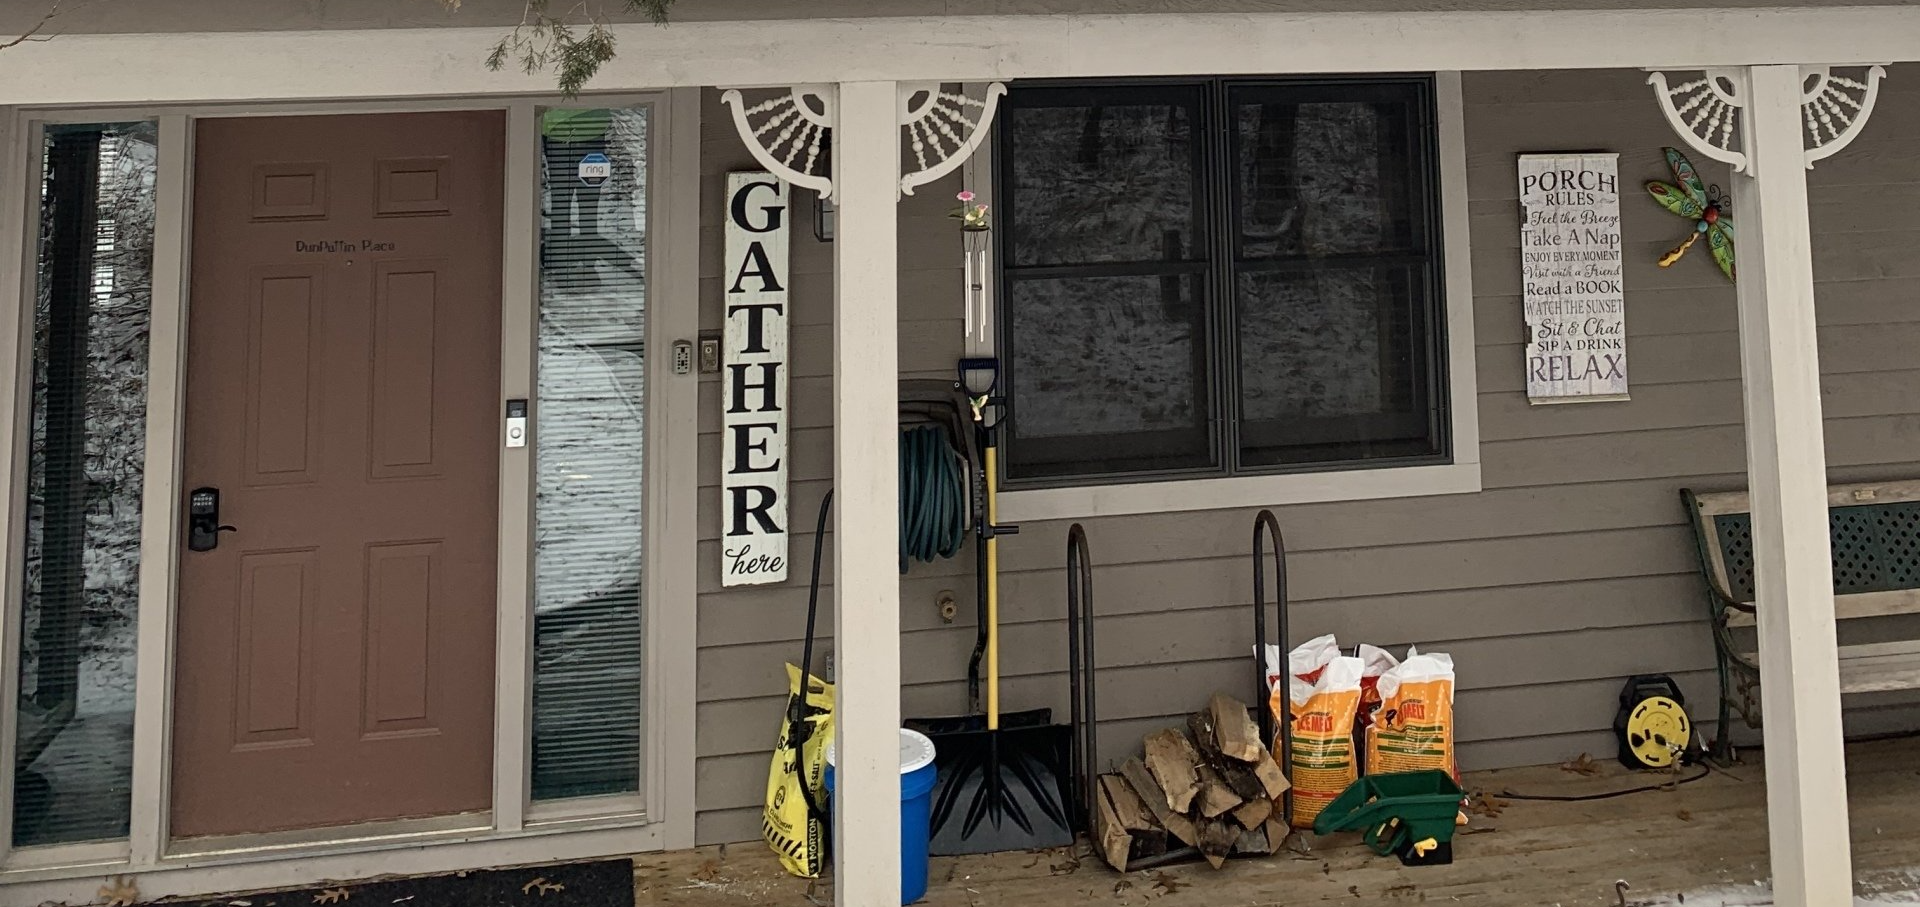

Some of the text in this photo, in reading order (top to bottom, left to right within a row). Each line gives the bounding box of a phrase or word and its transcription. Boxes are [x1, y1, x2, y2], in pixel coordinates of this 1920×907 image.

[586, 165, 604, 175] ring
[1522, 170, 1616, 196] PORCH
[1545, 192, 1595, 206] RULES
[1531, 210, 1619, 227] Feel the Breeze
[1521, 228, 1620, 249] Take A Nap
[1525, 250, 1620, 262] ENJOY EVERY MOMENT
[1523, 264, 1549, 278] Visit
[1551, 266, 1573, 277] with
[1584, 264, 1621, 278] Friend
[1527, 280, 1621, 296] Read a BOOK
[1526, 299, 1623, 316] WATCH THE SUNSET
[1537, 317, 1622, 338] Sit & Chat
[1538, 339, 1622, 352] SIP A DRINK
[726, 182, 786, 537] GATHER
[1529, 354, 1623, 383] RELAX
[725, 544, 785, 575] here
